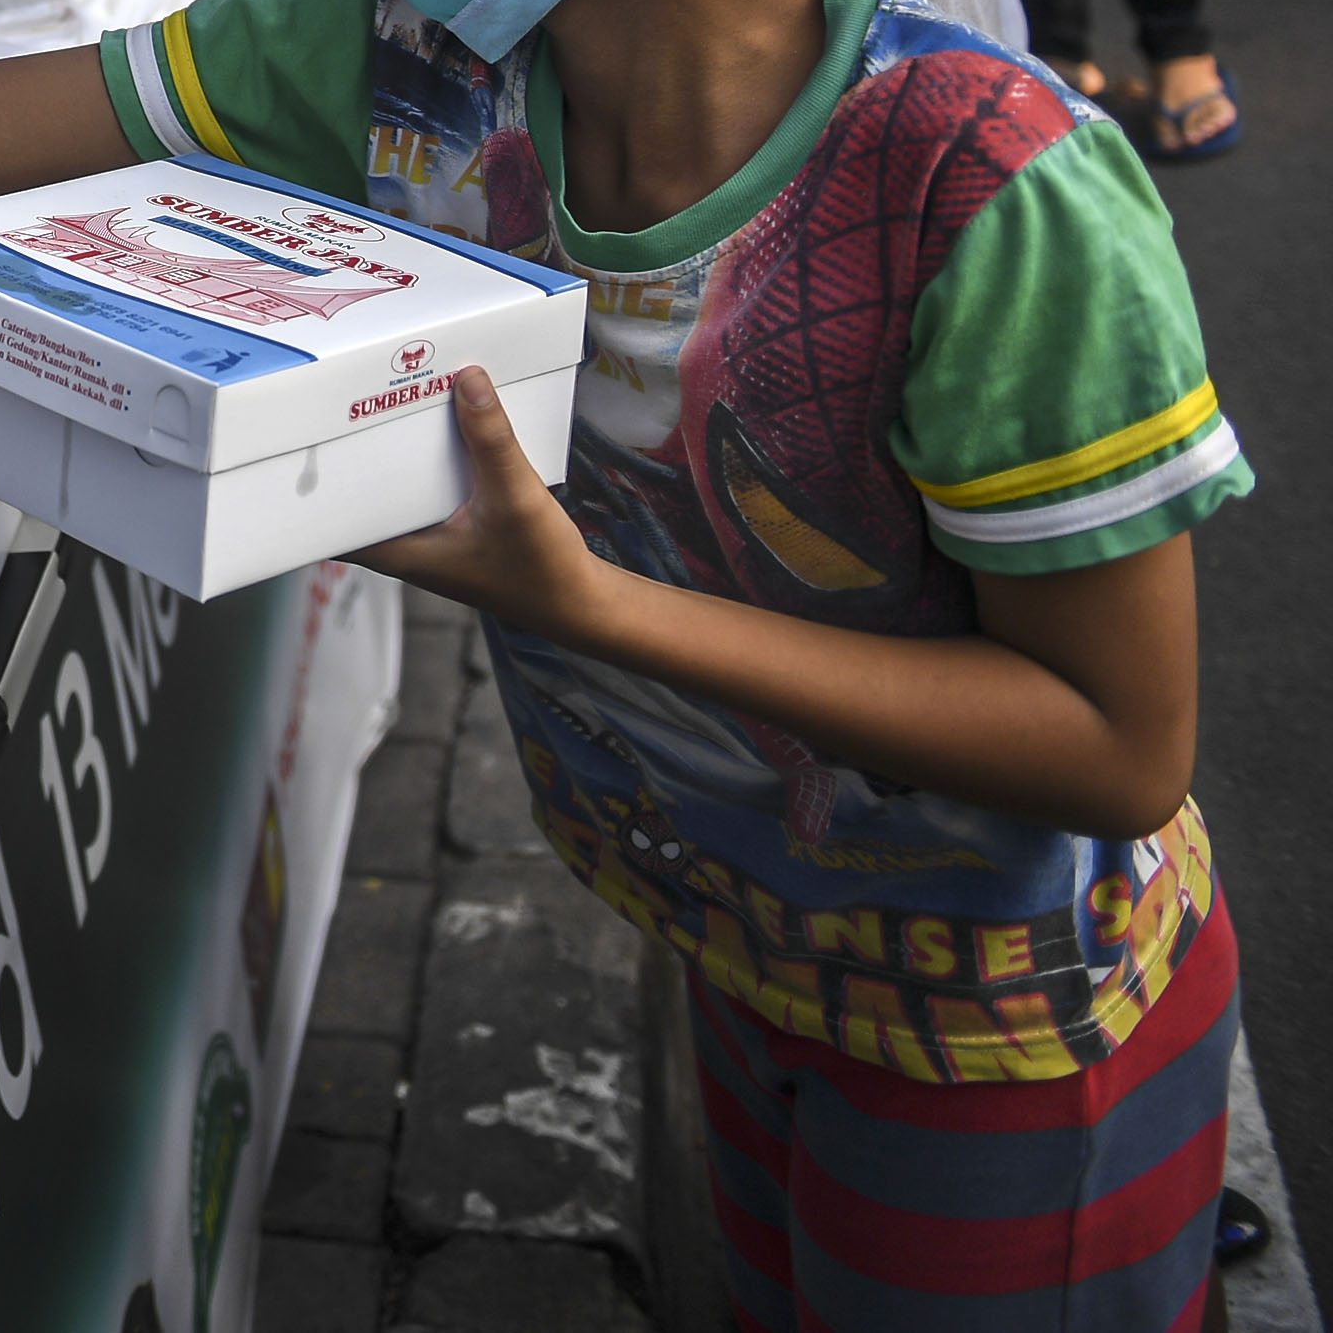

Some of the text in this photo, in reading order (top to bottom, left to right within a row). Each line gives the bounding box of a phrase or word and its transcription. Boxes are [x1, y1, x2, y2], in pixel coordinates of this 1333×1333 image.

[146, 194, 420, 289] SUMBER JAYA
[254, 215, 356, 251] RUMAH MAKAN
[5, 351, 42, 377] kambing
[44, 371, 69, 387] untuk
[71, 382, 106, 405] akekah,
[111, 382, 124, 395] dll
[349, 370, 460, 422] SUMBER JAY
[38, 650, 113, 929] 13
